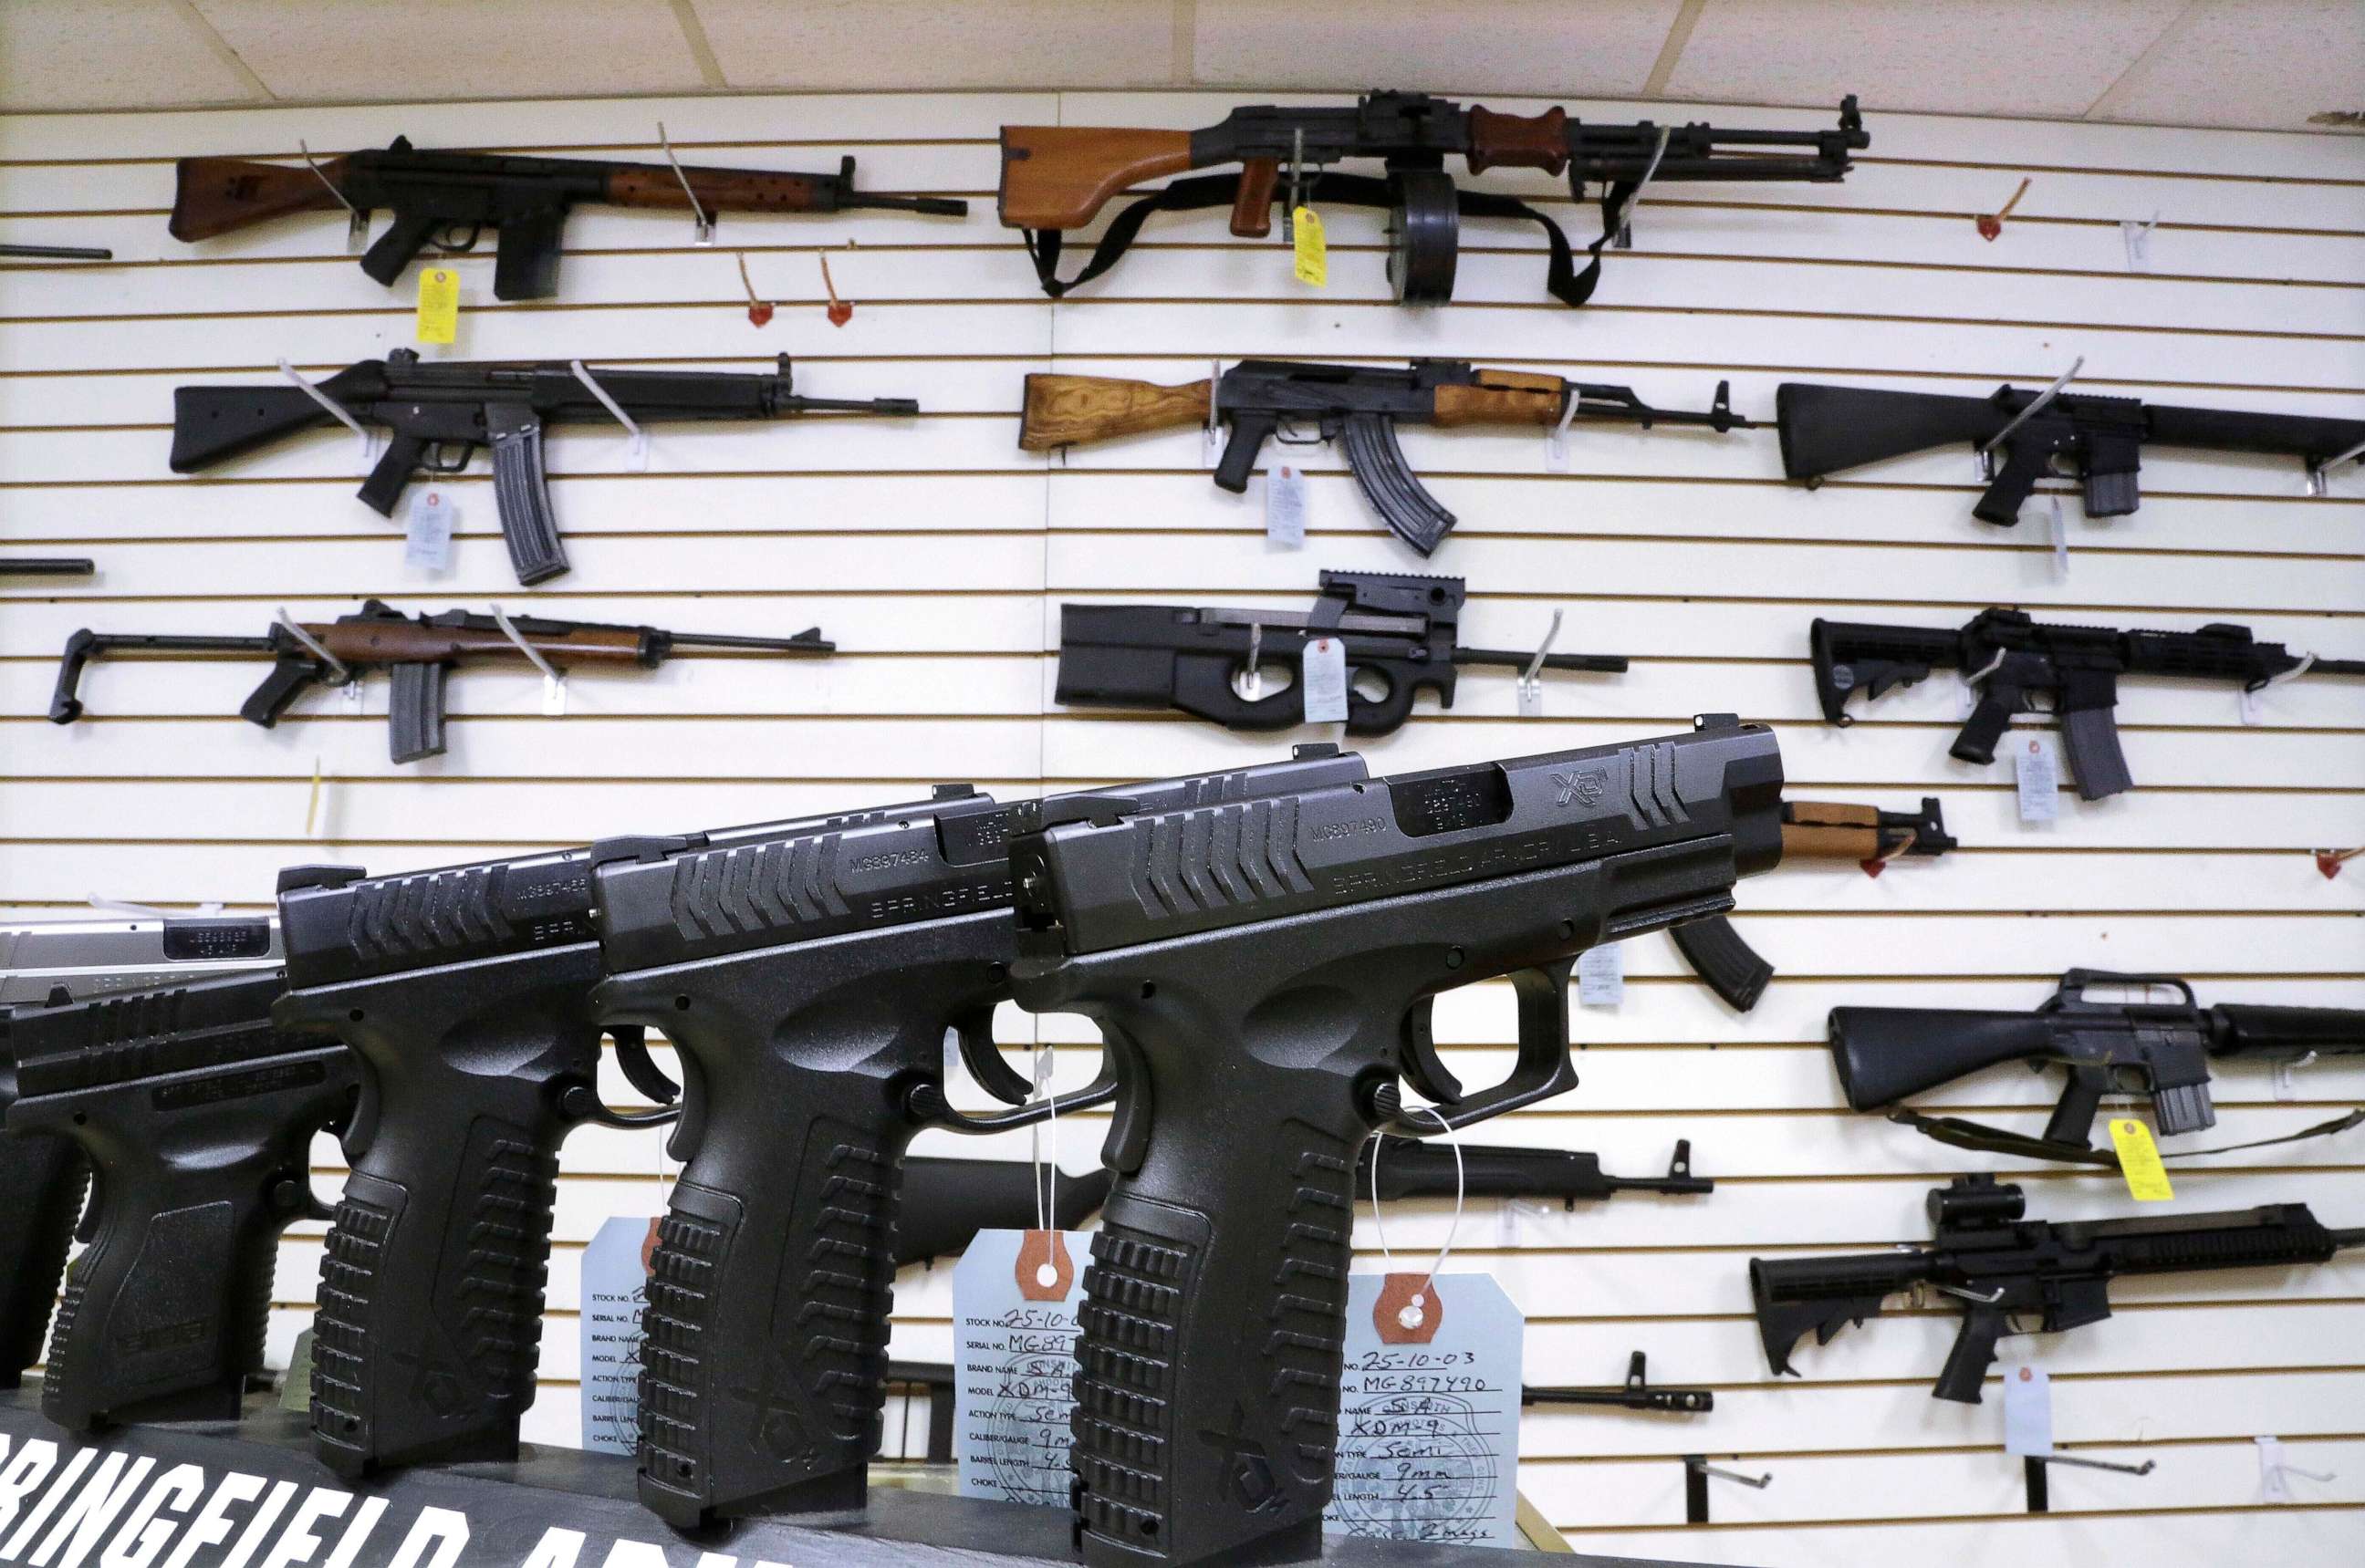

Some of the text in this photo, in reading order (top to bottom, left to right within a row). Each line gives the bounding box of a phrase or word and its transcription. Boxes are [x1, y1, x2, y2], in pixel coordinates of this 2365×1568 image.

[591, 1293, 616, 1303] STOCK
[591, 1314, 614, 1322] SERIAL
[965, 1317, 990, 1327] STOCK
[591, 1334, 617, 1343] BRAND
[966, 1341, 990, 1350] SERIAL
[591, 1355, 617, 1363] MODEL
[967, 1364, 1018, 1375] BRAND NAME
[591, 1375, 619, 1384] ACTION
[968, 1386, 994, 1397] MODEL
[1342, 1386, 1359, 1394] NO.
[592, 1415, 618, 1423] BARREL
[968, 1410, 1016, 1421] ACTION TYPE
[592, 1434, 618, 1443] CHOKE
[969, 1432, 1030, 1445] CALIBER/GAUGE
[1349, 1450, 1367, 1459] TYPE
[970, 1455, 1030, 1468] BARREL LENGTH
[971, 1478, 997, 1488] CHOKE
[1343, 1493, 1380, 1501] LENGTH
